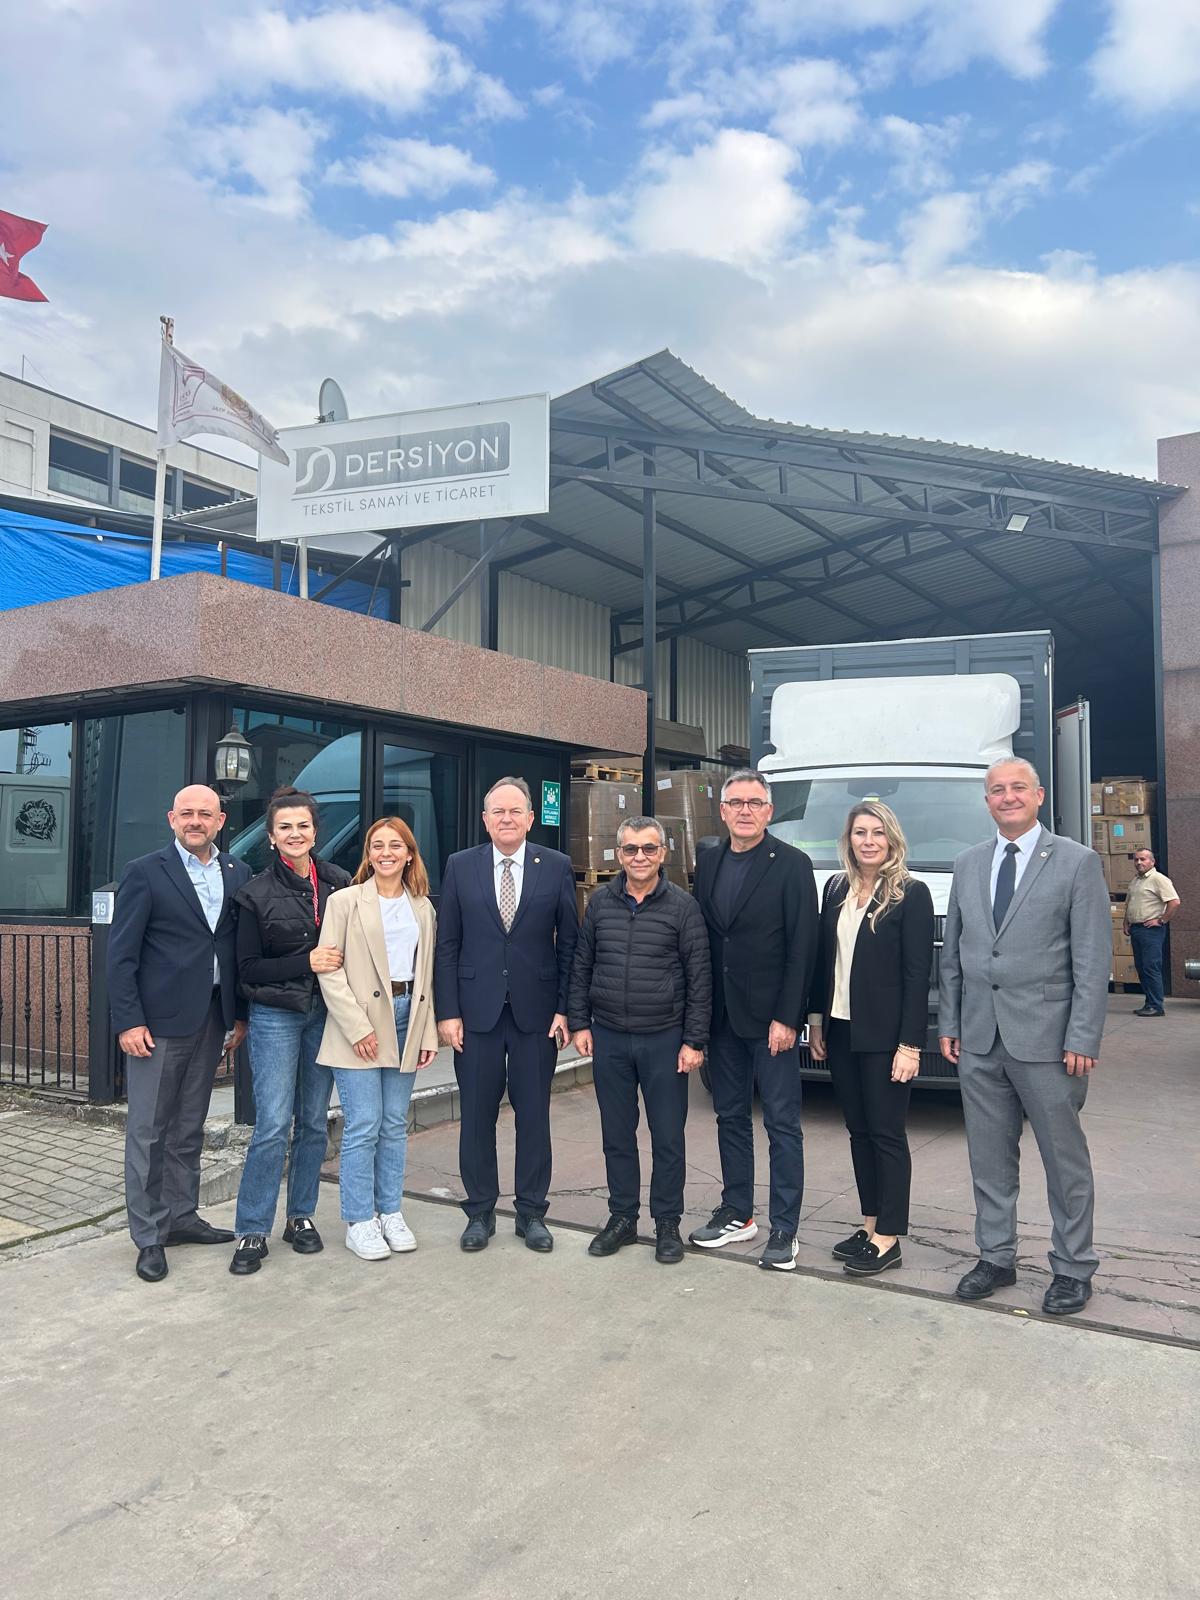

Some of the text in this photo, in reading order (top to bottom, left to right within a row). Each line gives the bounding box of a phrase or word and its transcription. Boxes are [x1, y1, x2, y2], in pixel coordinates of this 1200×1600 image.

[345, 436, 499, 477] DERSİYON
[303, 484, 496, 517] TEKSTİL SANAYİ VE TİCARET
[94, 902, 107, 916] 19
